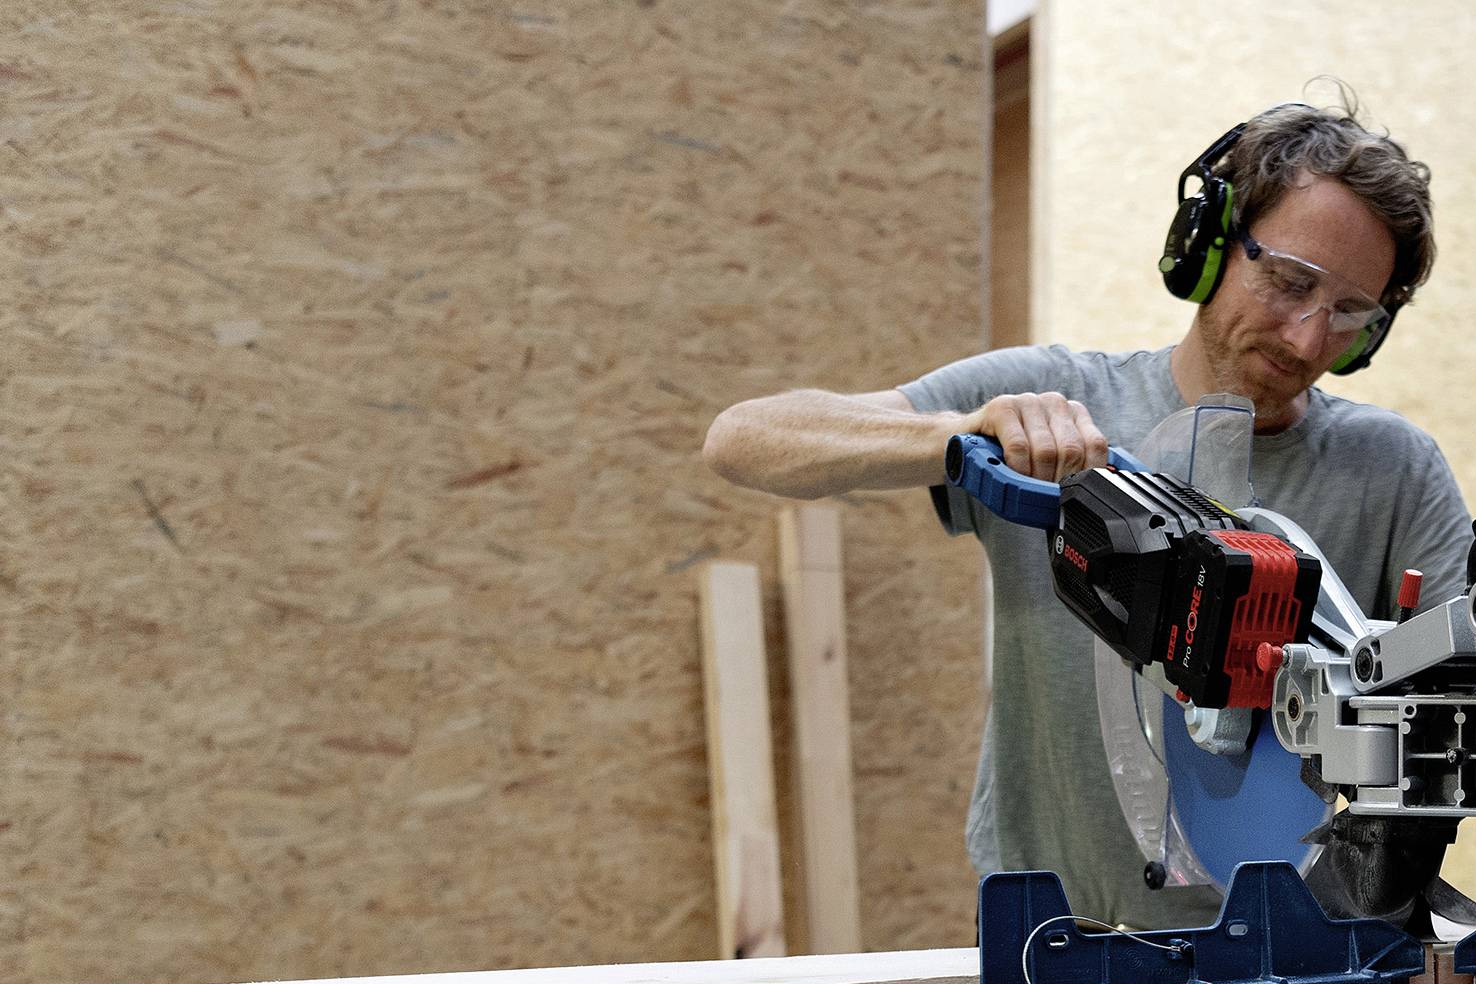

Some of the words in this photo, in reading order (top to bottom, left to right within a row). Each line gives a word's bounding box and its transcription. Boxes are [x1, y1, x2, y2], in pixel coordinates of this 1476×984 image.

[1064, 544, 1088, 573] BOSCH
[1197, 564, 1206, 587] 18V
[1186, 586, 1202, 645] CORE
[1183, 646, 1192, 668] Pro
